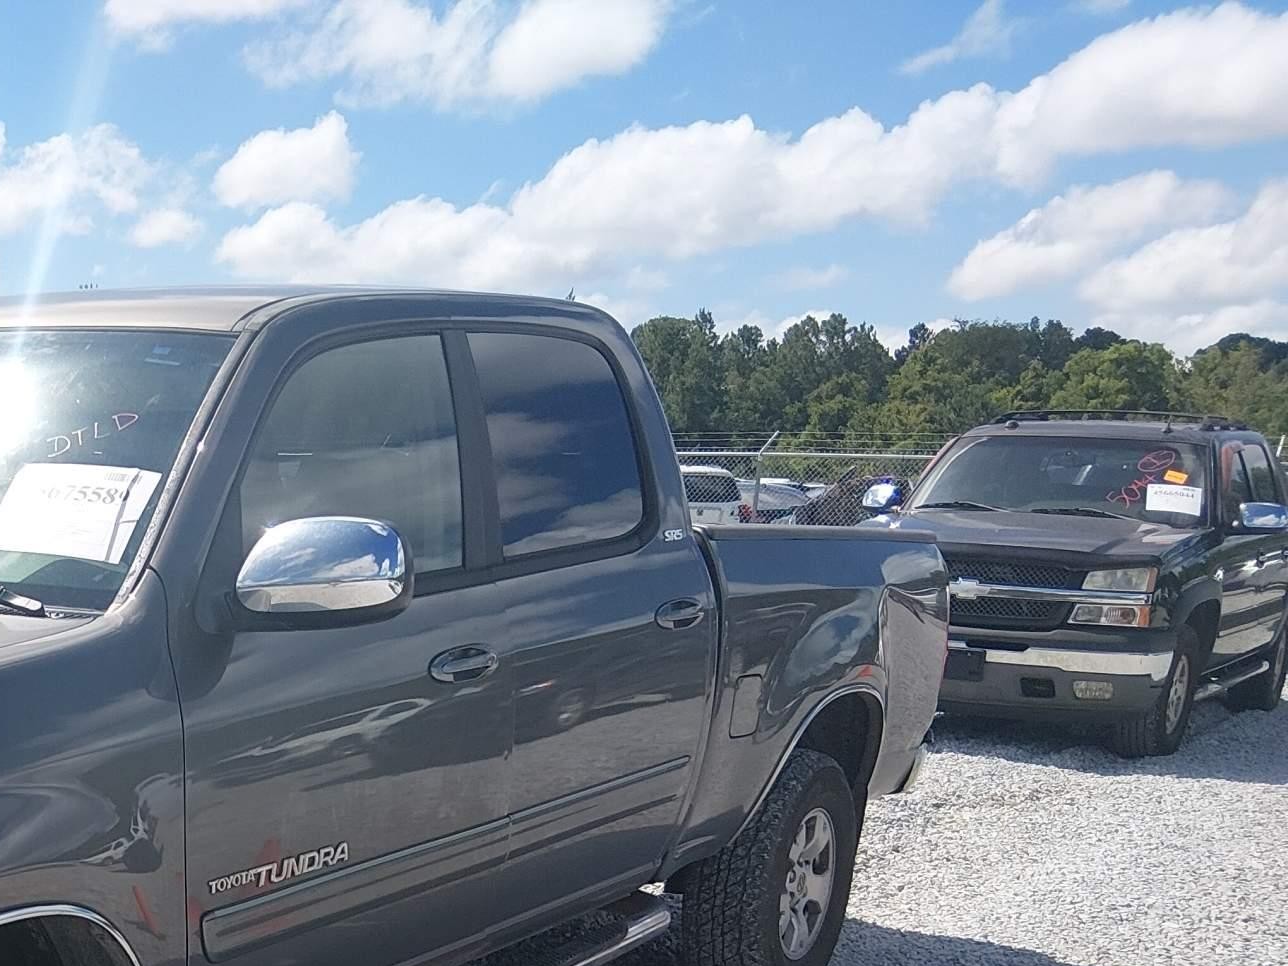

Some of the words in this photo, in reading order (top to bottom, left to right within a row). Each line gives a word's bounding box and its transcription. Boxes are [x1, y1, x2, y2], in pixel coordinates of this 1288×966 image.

[664, 529, 683, 542] SR5
[208, 869, 256, 894] TOYOTA
[255, 842, 349, 888] TUNDRA
